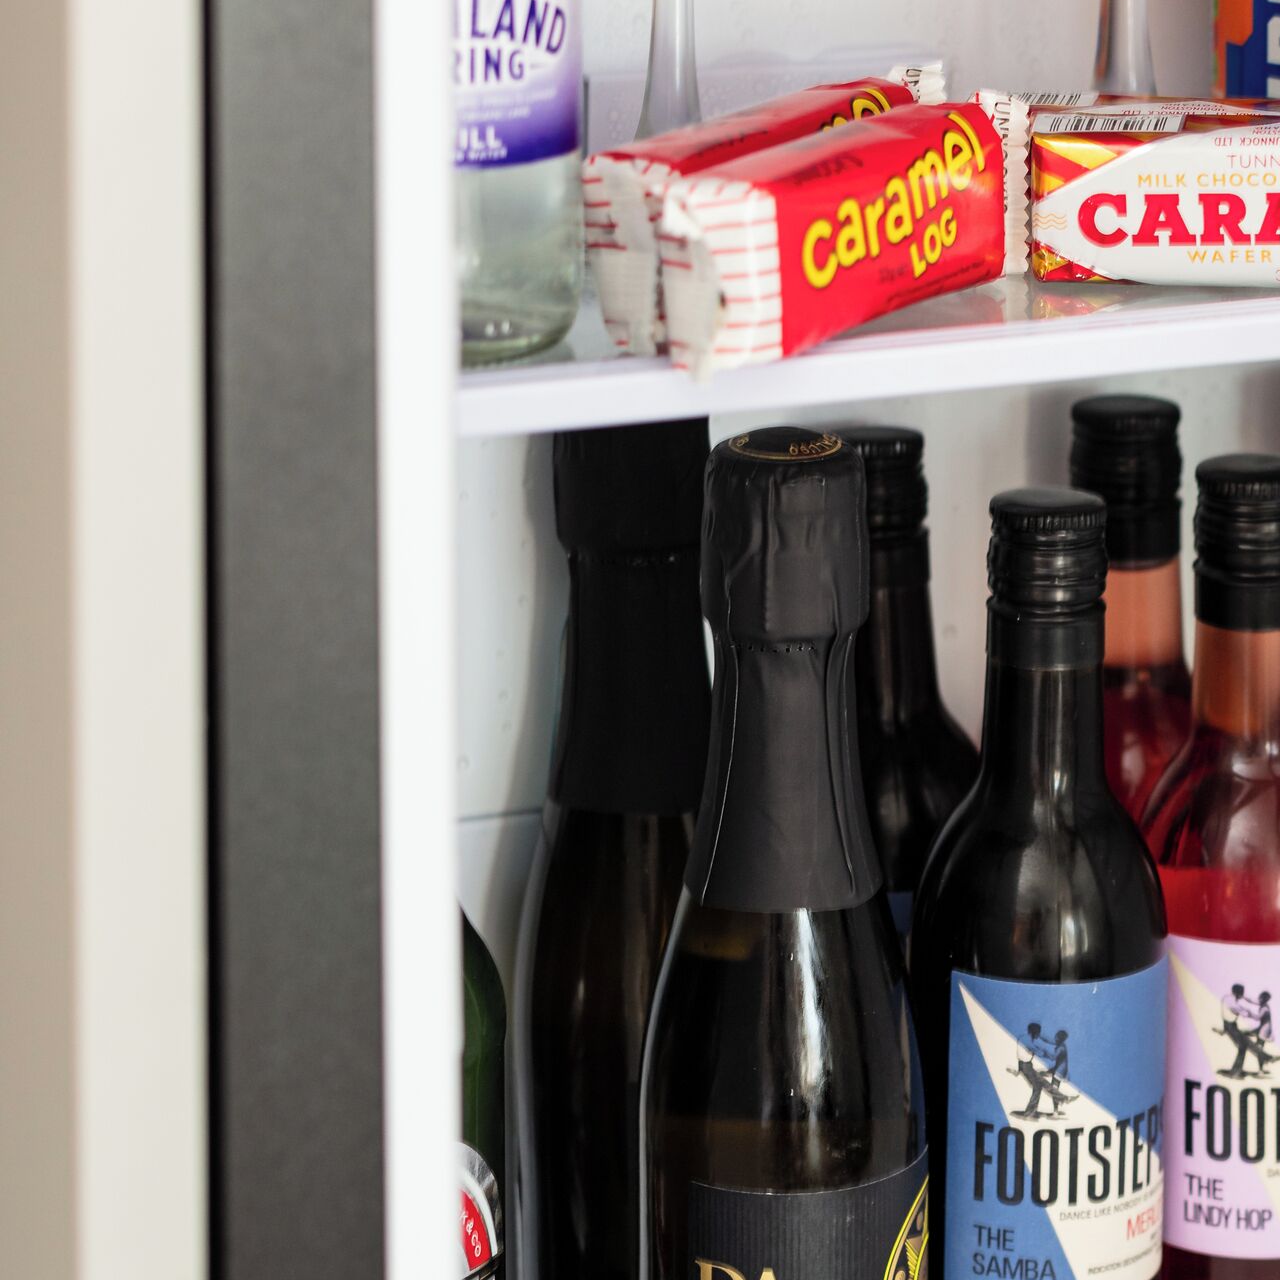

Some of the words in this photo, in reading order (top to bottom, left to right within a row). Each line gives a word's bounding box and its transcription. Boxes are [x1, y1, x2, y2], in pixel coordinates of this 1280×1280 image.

[1137, 173, 1187, 188] MILK
[909, 206, 958, 280] LOG
[1187, 247, 1273, 264] WAFER
[973, 1105, 1163, 1207] FOOTSTEP
[1185, 1172, 1224, 1201] THE
[1059, 1208, 1091, 1222] DANCE
[1094, 1205, 1112, 1218] LIKE
[1184, 1199, 1233, 1230] LINDY
[1236, 1208, 1273, 1231] HOP
[973, 1223, 1015, 1252] THE
